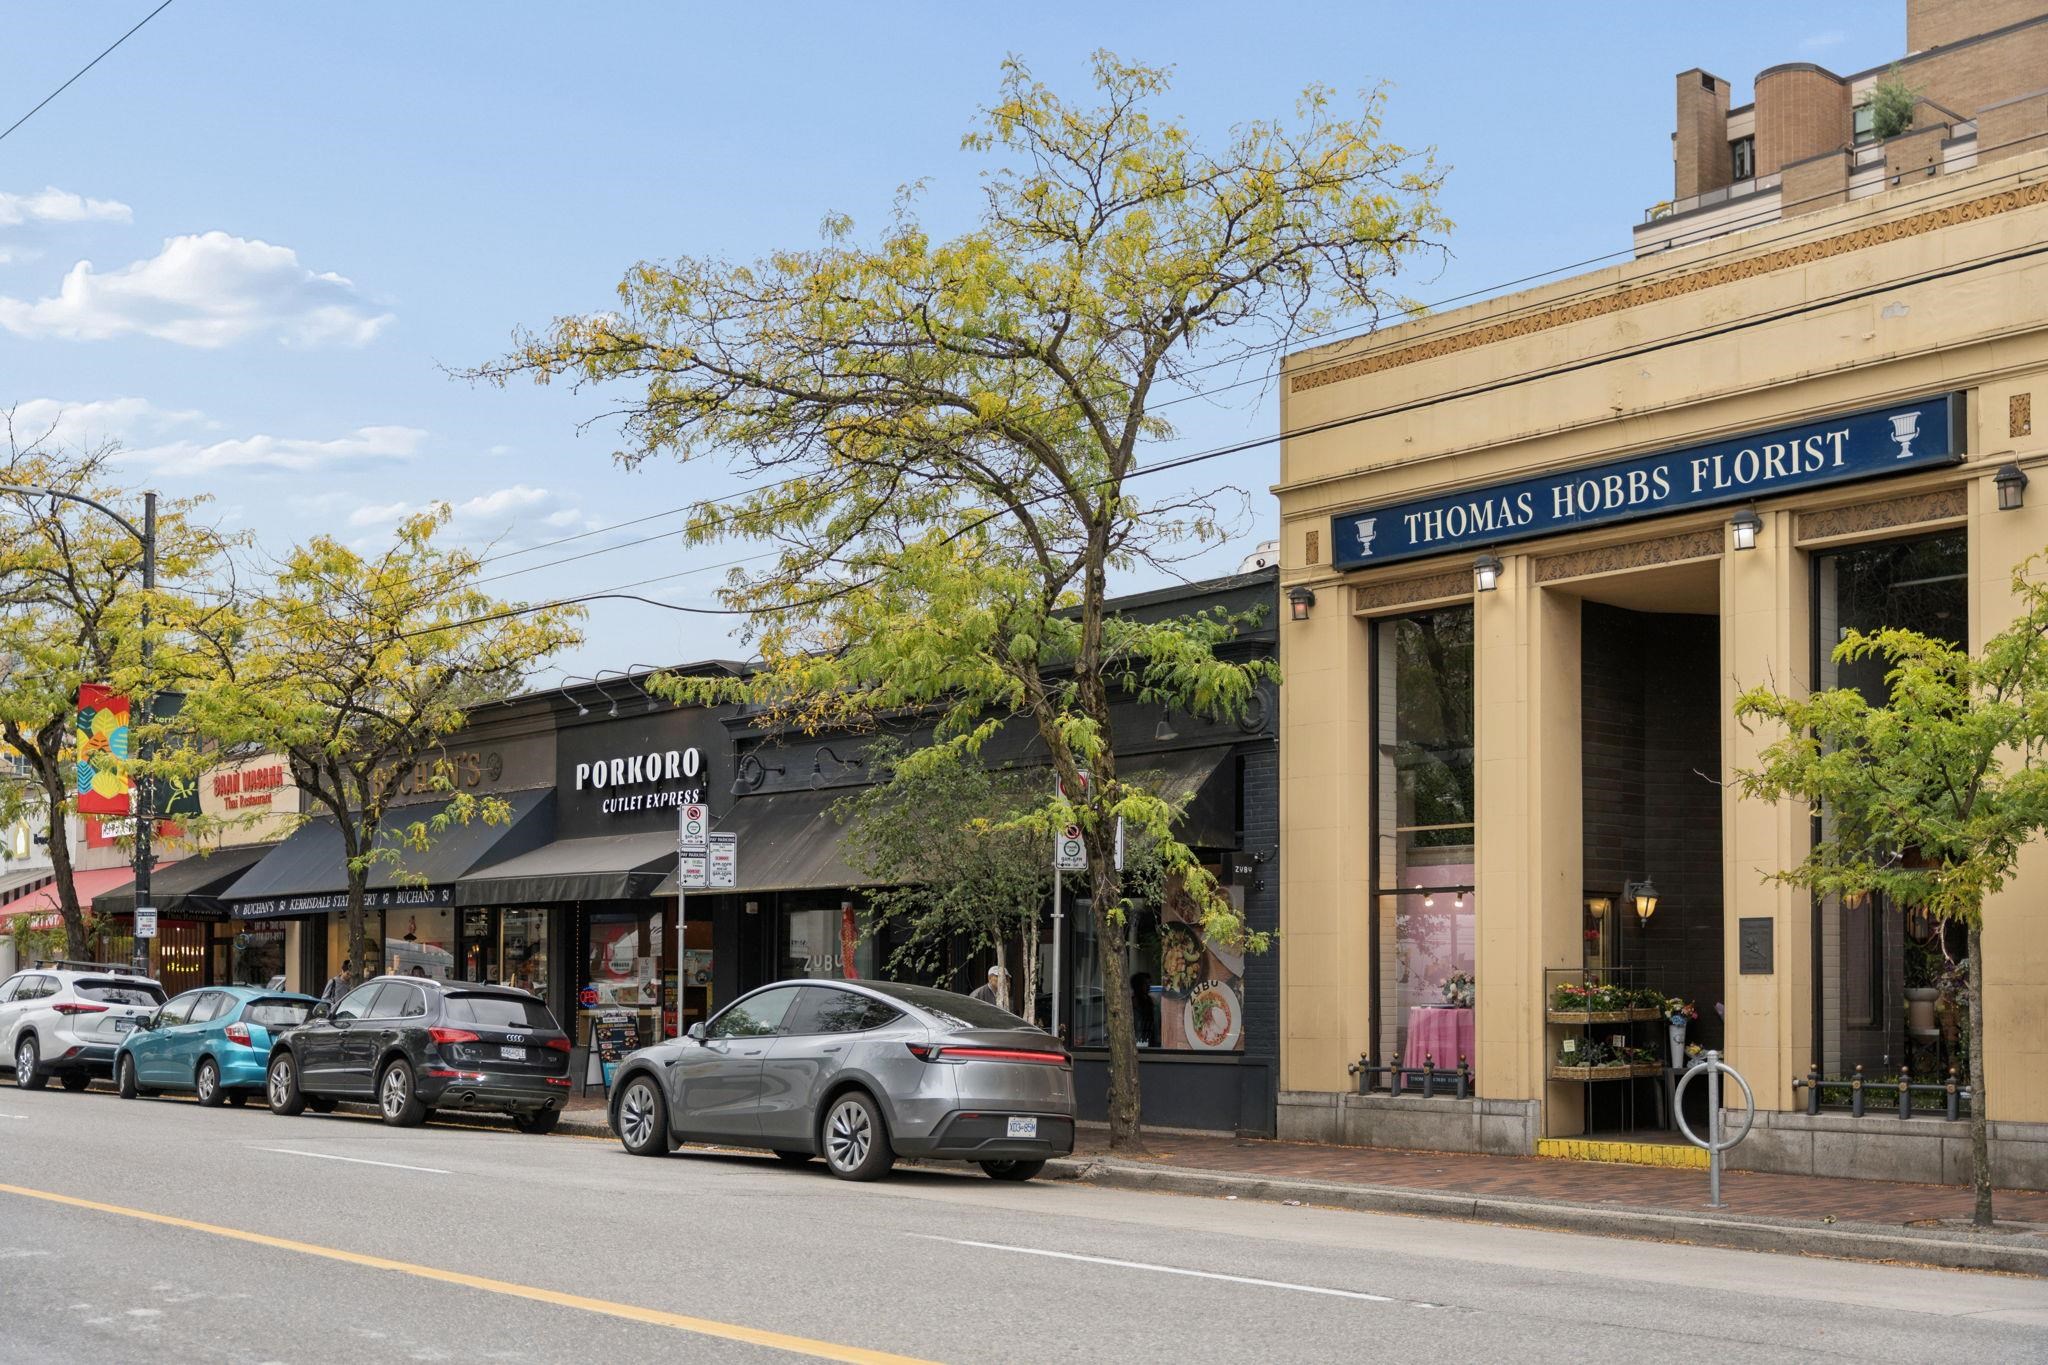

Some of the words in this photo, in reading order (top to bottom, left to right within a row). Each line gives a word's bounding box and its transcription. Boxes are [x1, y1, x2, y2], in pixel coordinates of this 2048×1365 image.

[1404, 492, 1534, 545] THOMAS
[1551, 465, 1671, 519] HOBBS
[1690, 428, 1849, 494] FLORIST
[213, 773, 240, 798] BAAN
[242, 764, 284, 793] WASANA
[576, 747, 699, 791] PORKORO
[224, 795, 239, 810] Thai
[239, 793, 272, 809] Restaurant
[602, 795, 643, 814] CUTLET
[646, 788, 699, 809] EXPRESS
[1235, 865, 1253, 873] ZUBU
[243, 900, 275, 915] BUCHAN'S
[289, 895, 331, 911] KERRISDALE
[396, 889, 436, 904] BUCHAN'S
[580, 990, 599, 1005] OPEN
